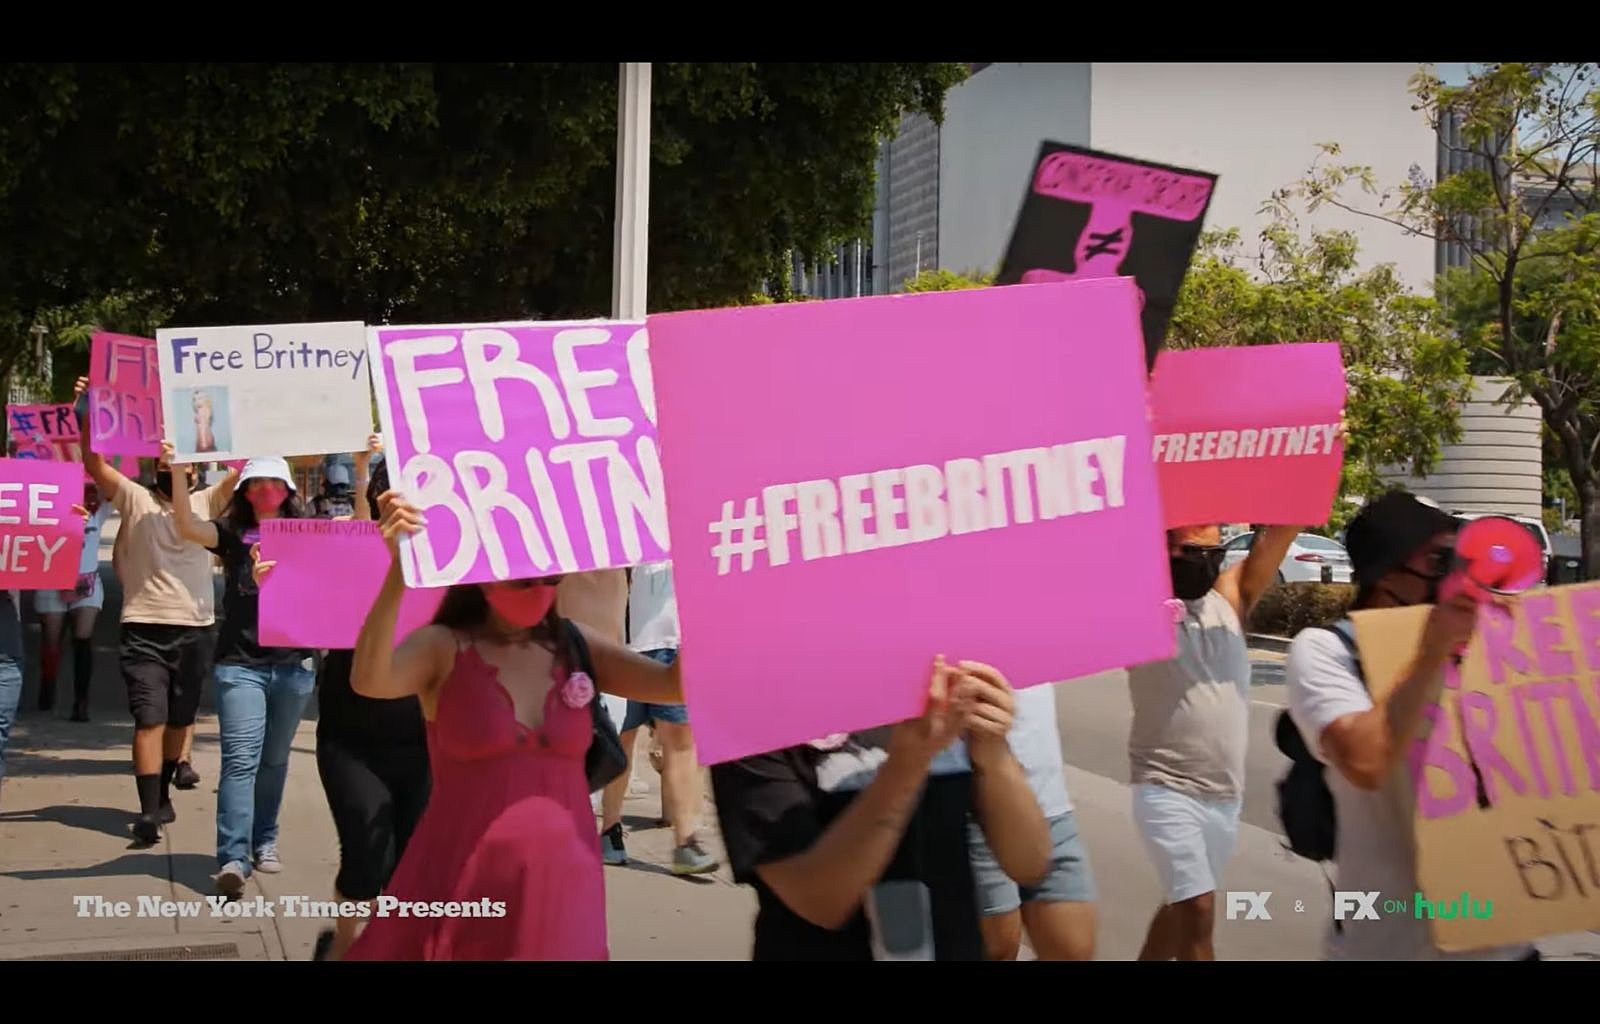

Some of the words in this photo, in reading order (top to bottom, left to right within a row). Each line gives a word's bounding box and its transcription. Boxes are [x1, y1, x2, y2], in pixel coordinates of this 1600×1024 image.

[171, 337, 244, 374] Free
[253, 332, 365, 380] Britney
[708, 435, 1127, 576] #FREEBRITNEY
